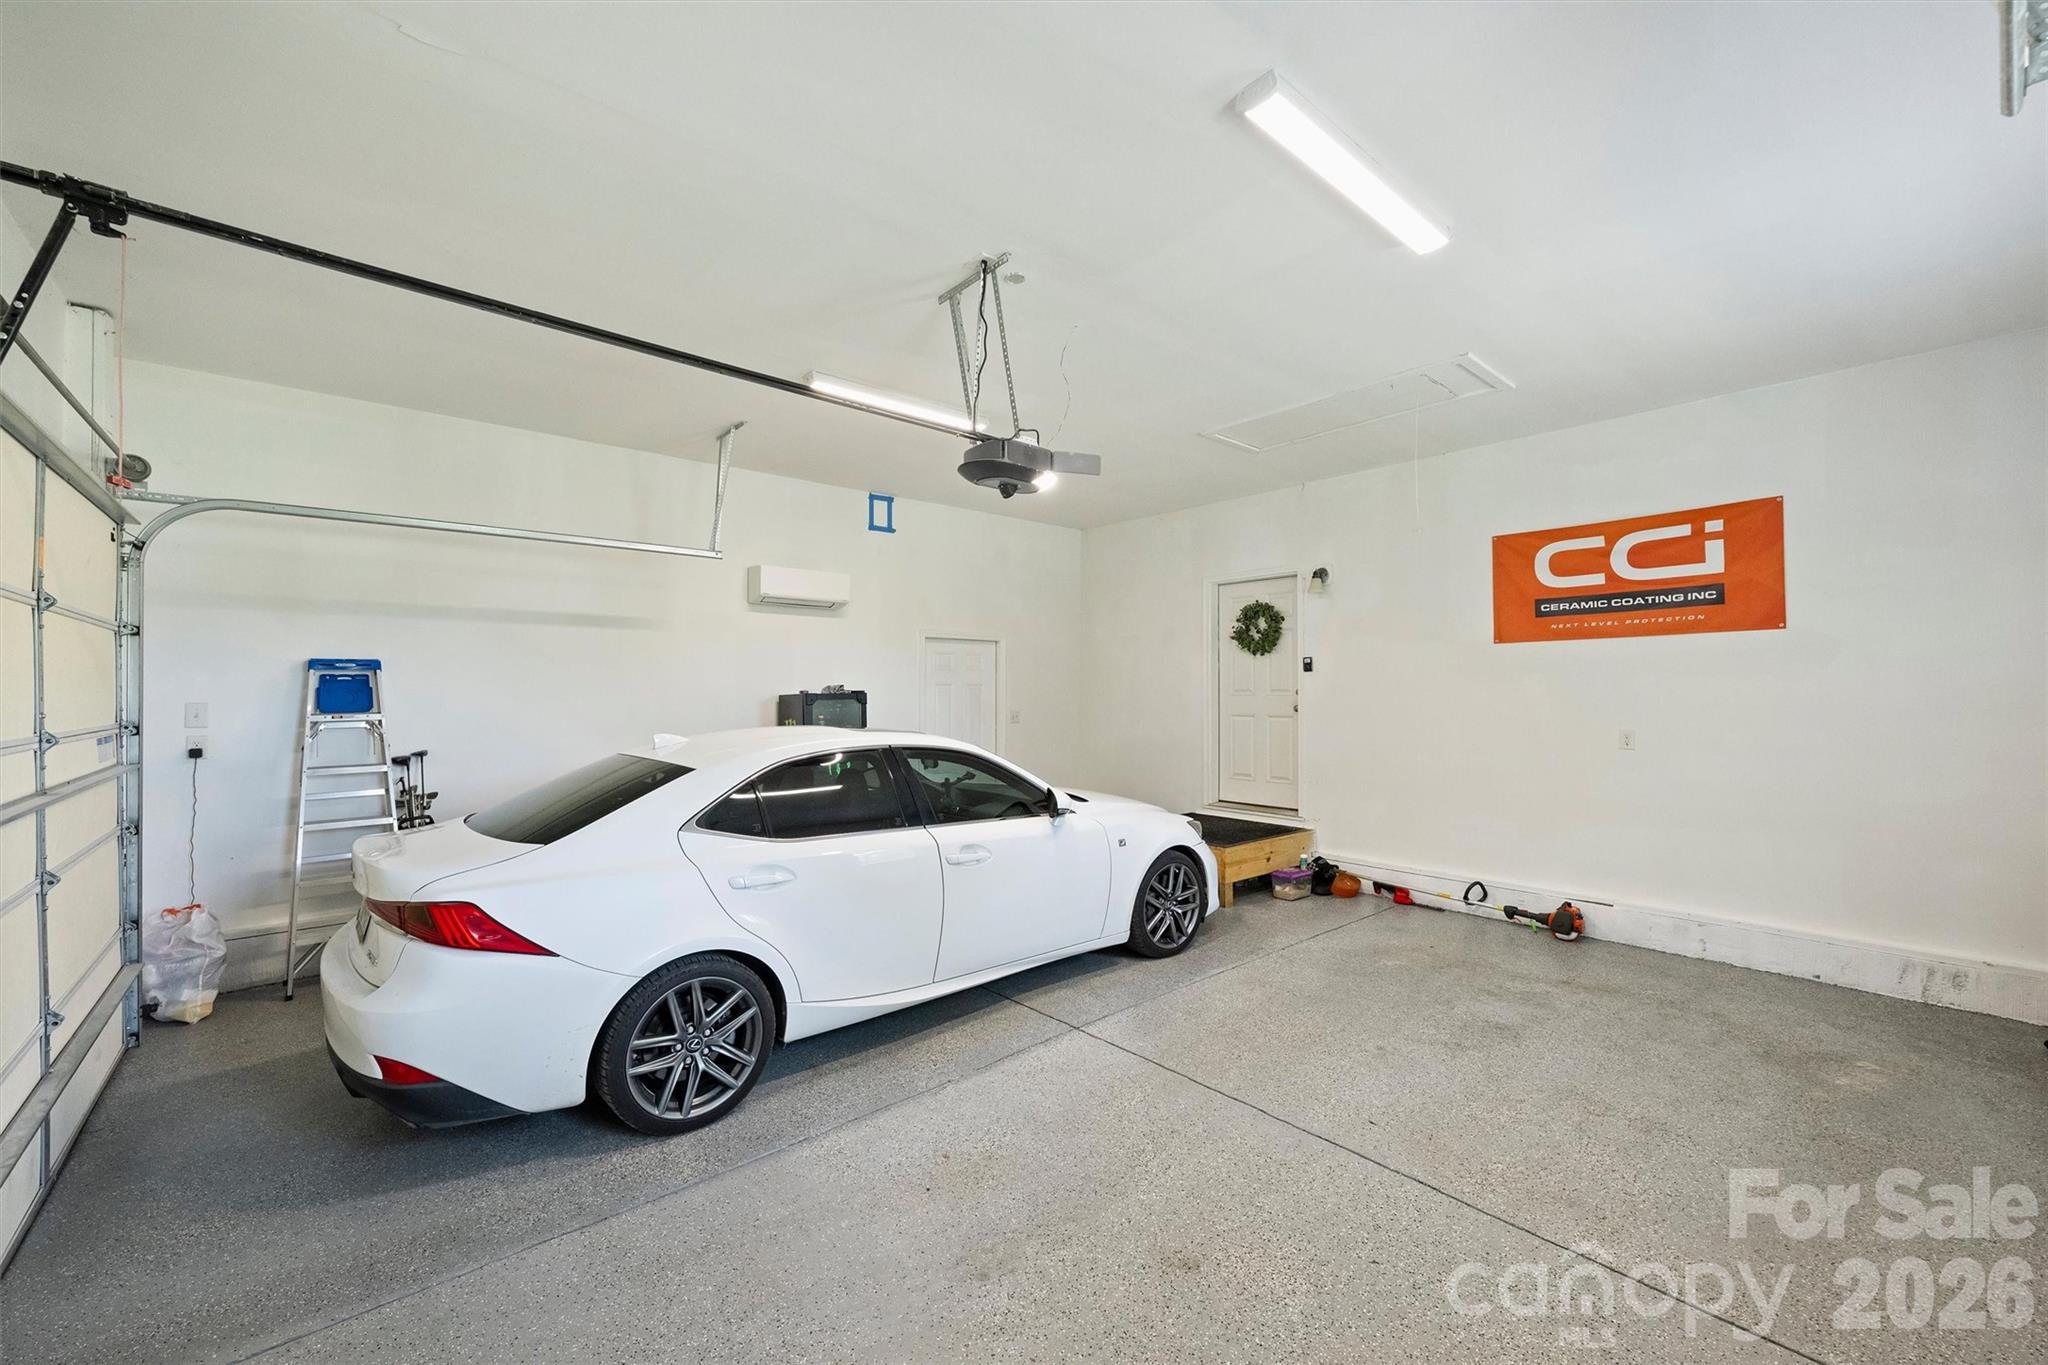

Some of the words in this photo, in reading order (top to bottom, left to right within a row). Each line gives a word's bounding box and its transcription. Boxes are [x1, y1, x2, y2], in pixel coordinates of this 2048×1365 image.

[1540, 599, 1608, 612] CERAMIC
[1611, 594, 1684, 606] COATING
[1687, 590, 1717, 600] INC
[1625, 615, 1705, 625] PROTECTION
